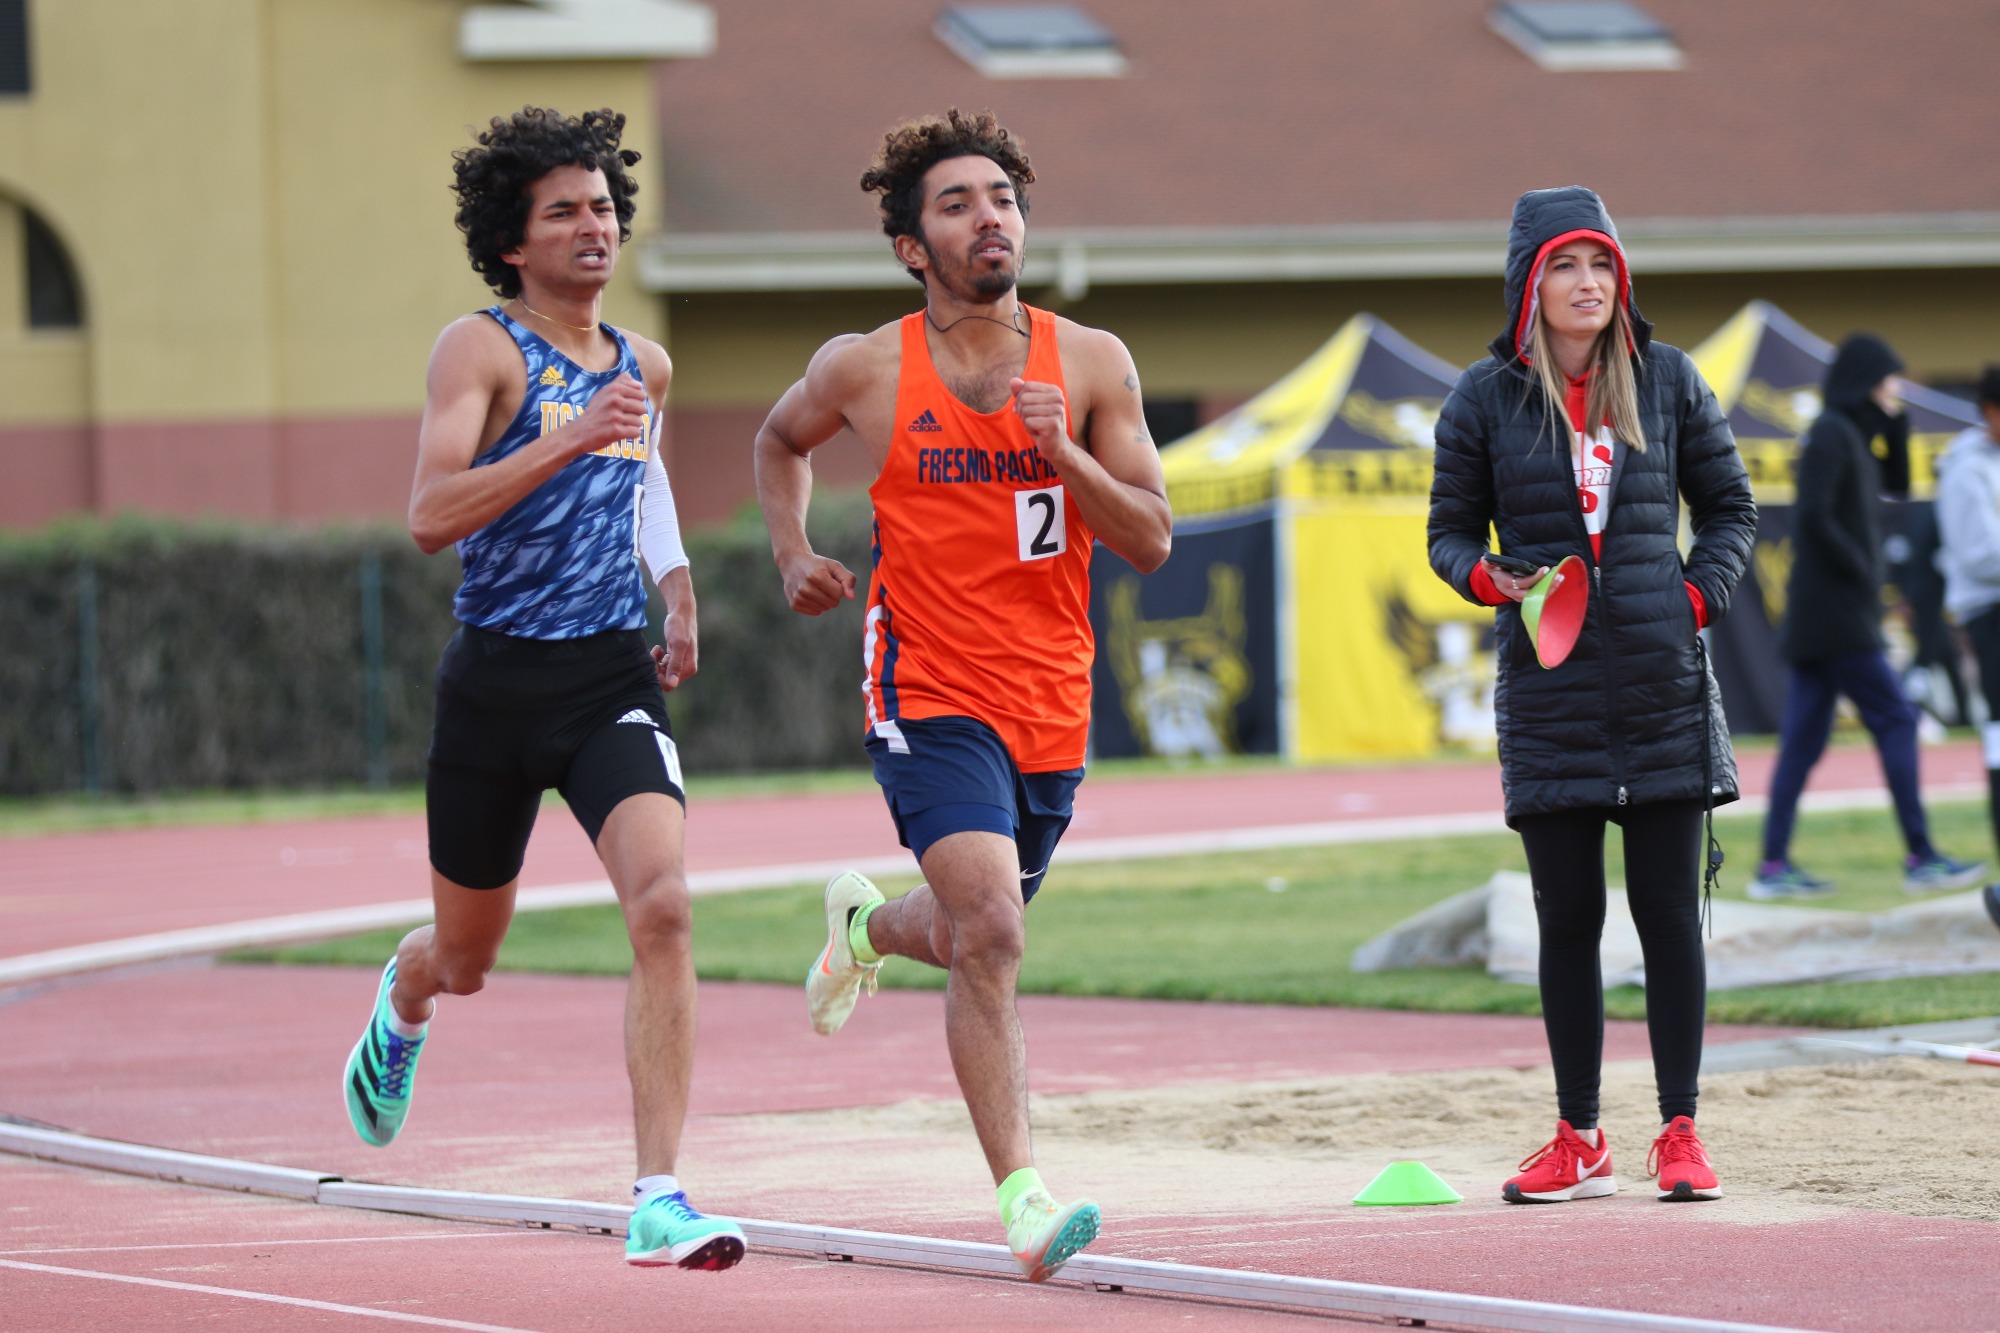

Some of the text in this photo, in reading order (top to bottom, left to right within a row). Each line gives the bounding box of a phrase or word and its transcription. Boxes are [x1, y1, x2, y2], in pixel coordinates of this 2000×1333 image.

[539, 376, 568, 387] adidas
[908, 423, 943, 432] adidas
[918, 447, 991, 483] FRESNO
[1027, 492, 1059, 556] 2
